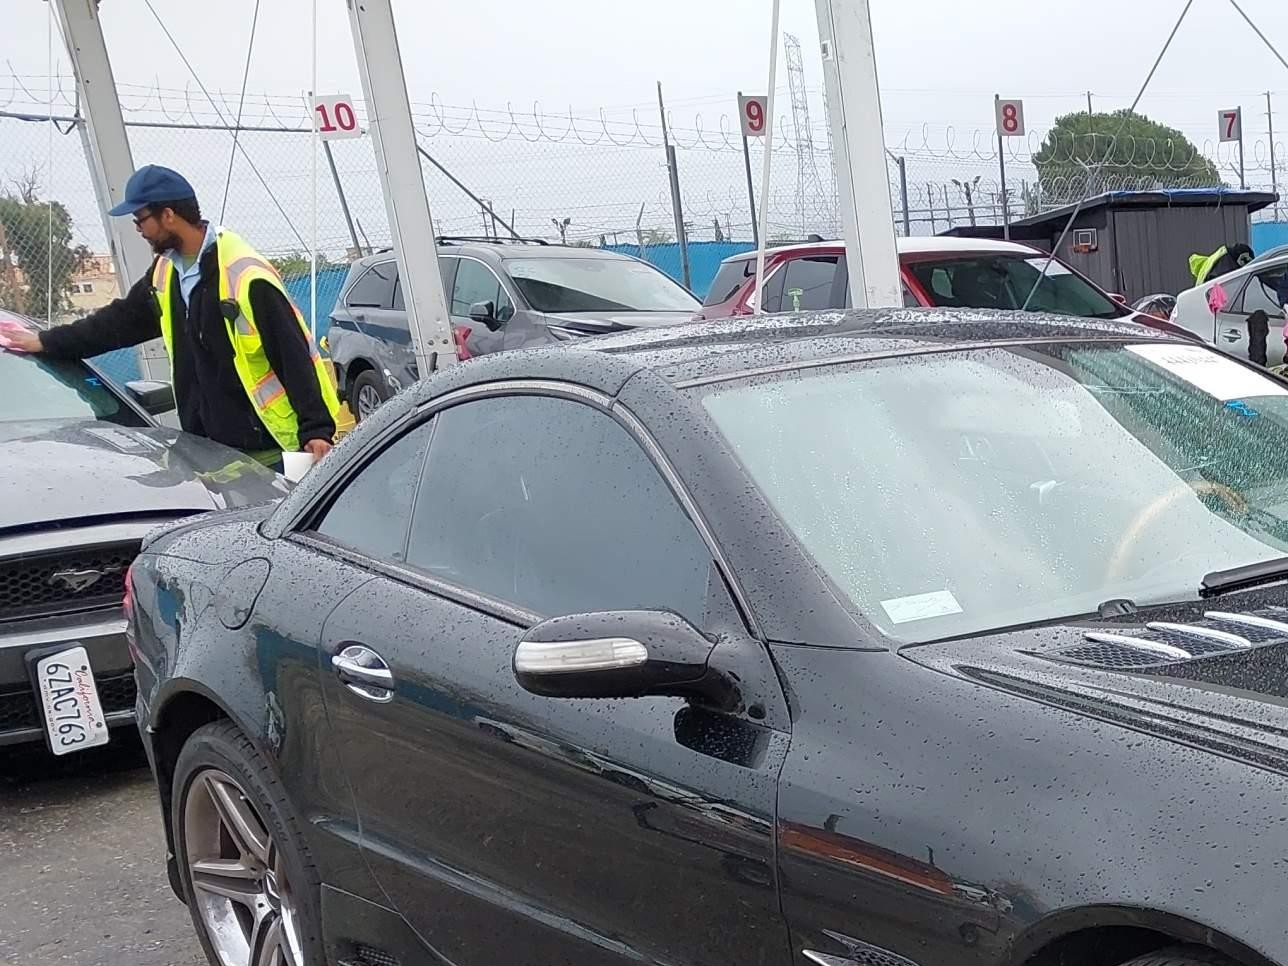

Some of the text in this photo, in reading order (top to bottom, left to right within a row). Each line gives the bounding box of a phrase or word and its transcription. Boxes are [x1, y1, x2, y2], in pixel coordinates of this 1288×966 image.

[315, 102, 356, 131] 10
[745, 100, 764, 131] 9
[1002, 103, 1018, 132] 8
[1223, 112, 1237, 138] 7
[46, 664, 86, 745] 6ZAC763
[74, 670, 94, 729] California
